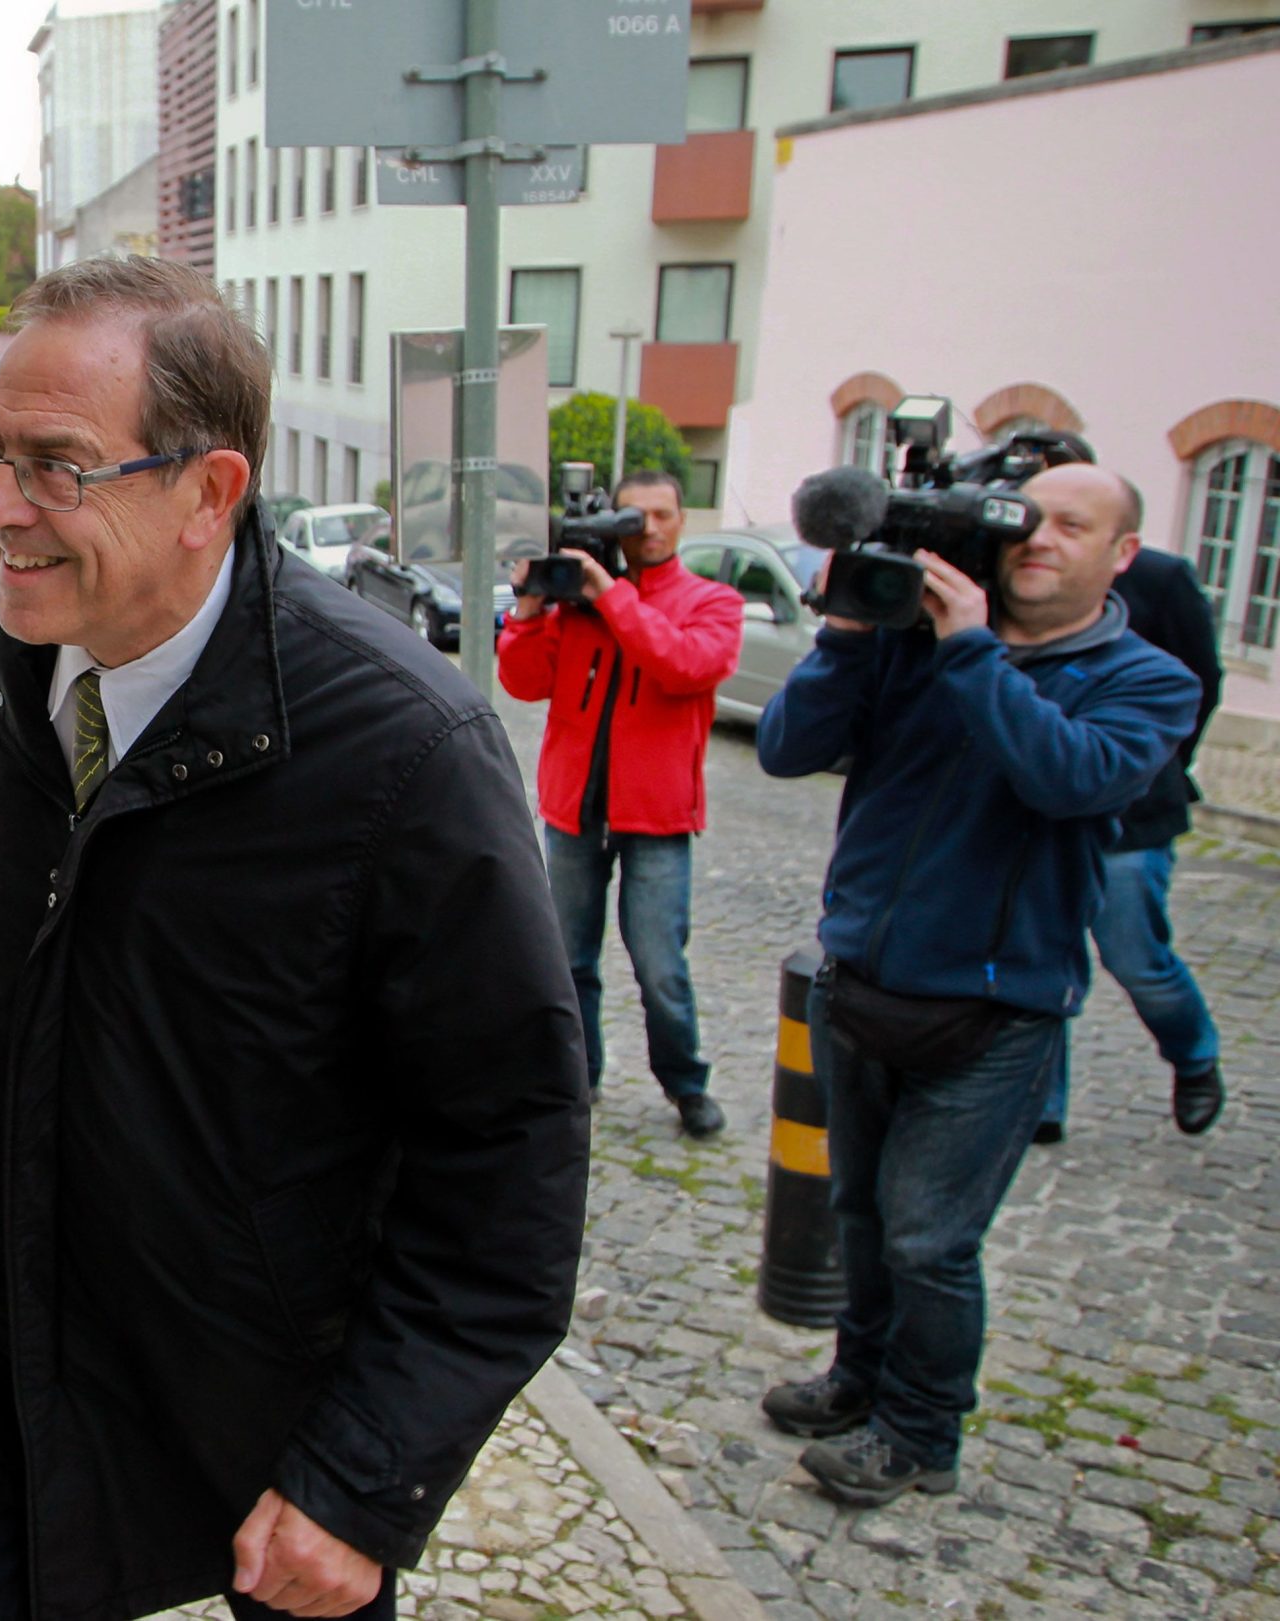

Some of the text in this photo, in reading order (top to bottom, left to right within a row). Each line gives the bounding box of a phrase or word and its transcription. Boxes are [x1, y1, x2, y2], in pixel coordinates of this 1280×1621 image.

[608, 14, 680, 34] 1066 A
[396, 166, 440, 183] CML
[530, 165, 571, 182] XXV
